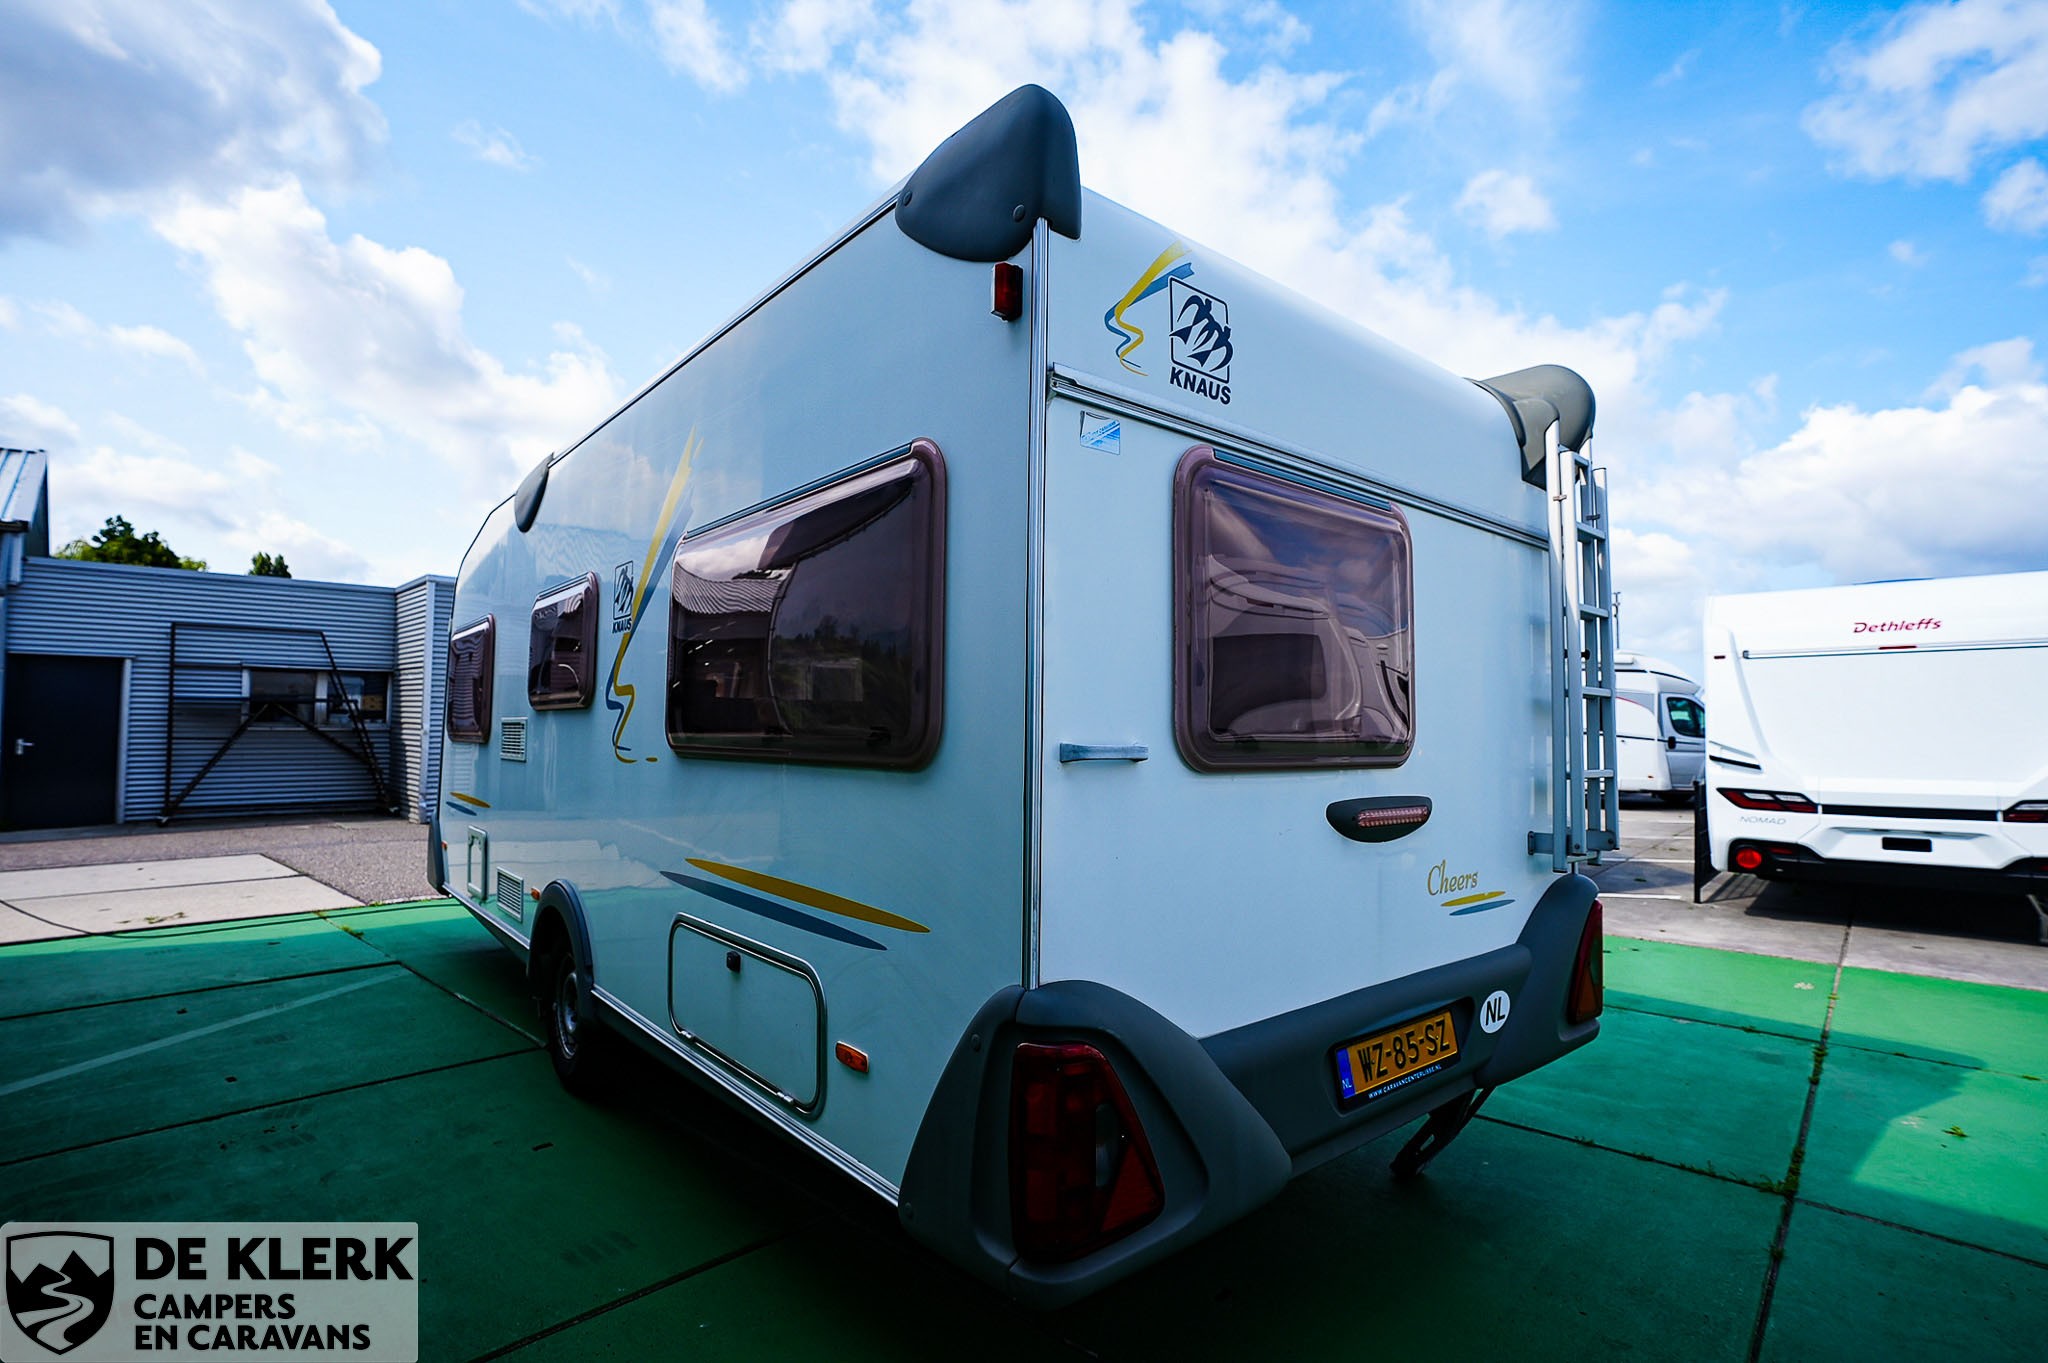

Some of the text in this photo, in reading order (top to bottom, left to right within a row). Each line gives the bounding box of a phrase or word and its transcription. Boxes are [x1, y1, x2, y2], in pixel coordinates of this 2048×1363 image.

[1169, 366, 1231, 405] KNAUS
[612, 618, 632, 634] KNAUS
[1853, 618, 1942, 633] Dethleffs
[1739, 815, 1787, 825] NOMAD
[1427, 859, 1478, 896] Cheers
[1485, 996, 1506, 1026] NL
[1357, 1018, 1450, 1083] WZ-85-SZ
[1341, 1078, 1352, 1090] NL
